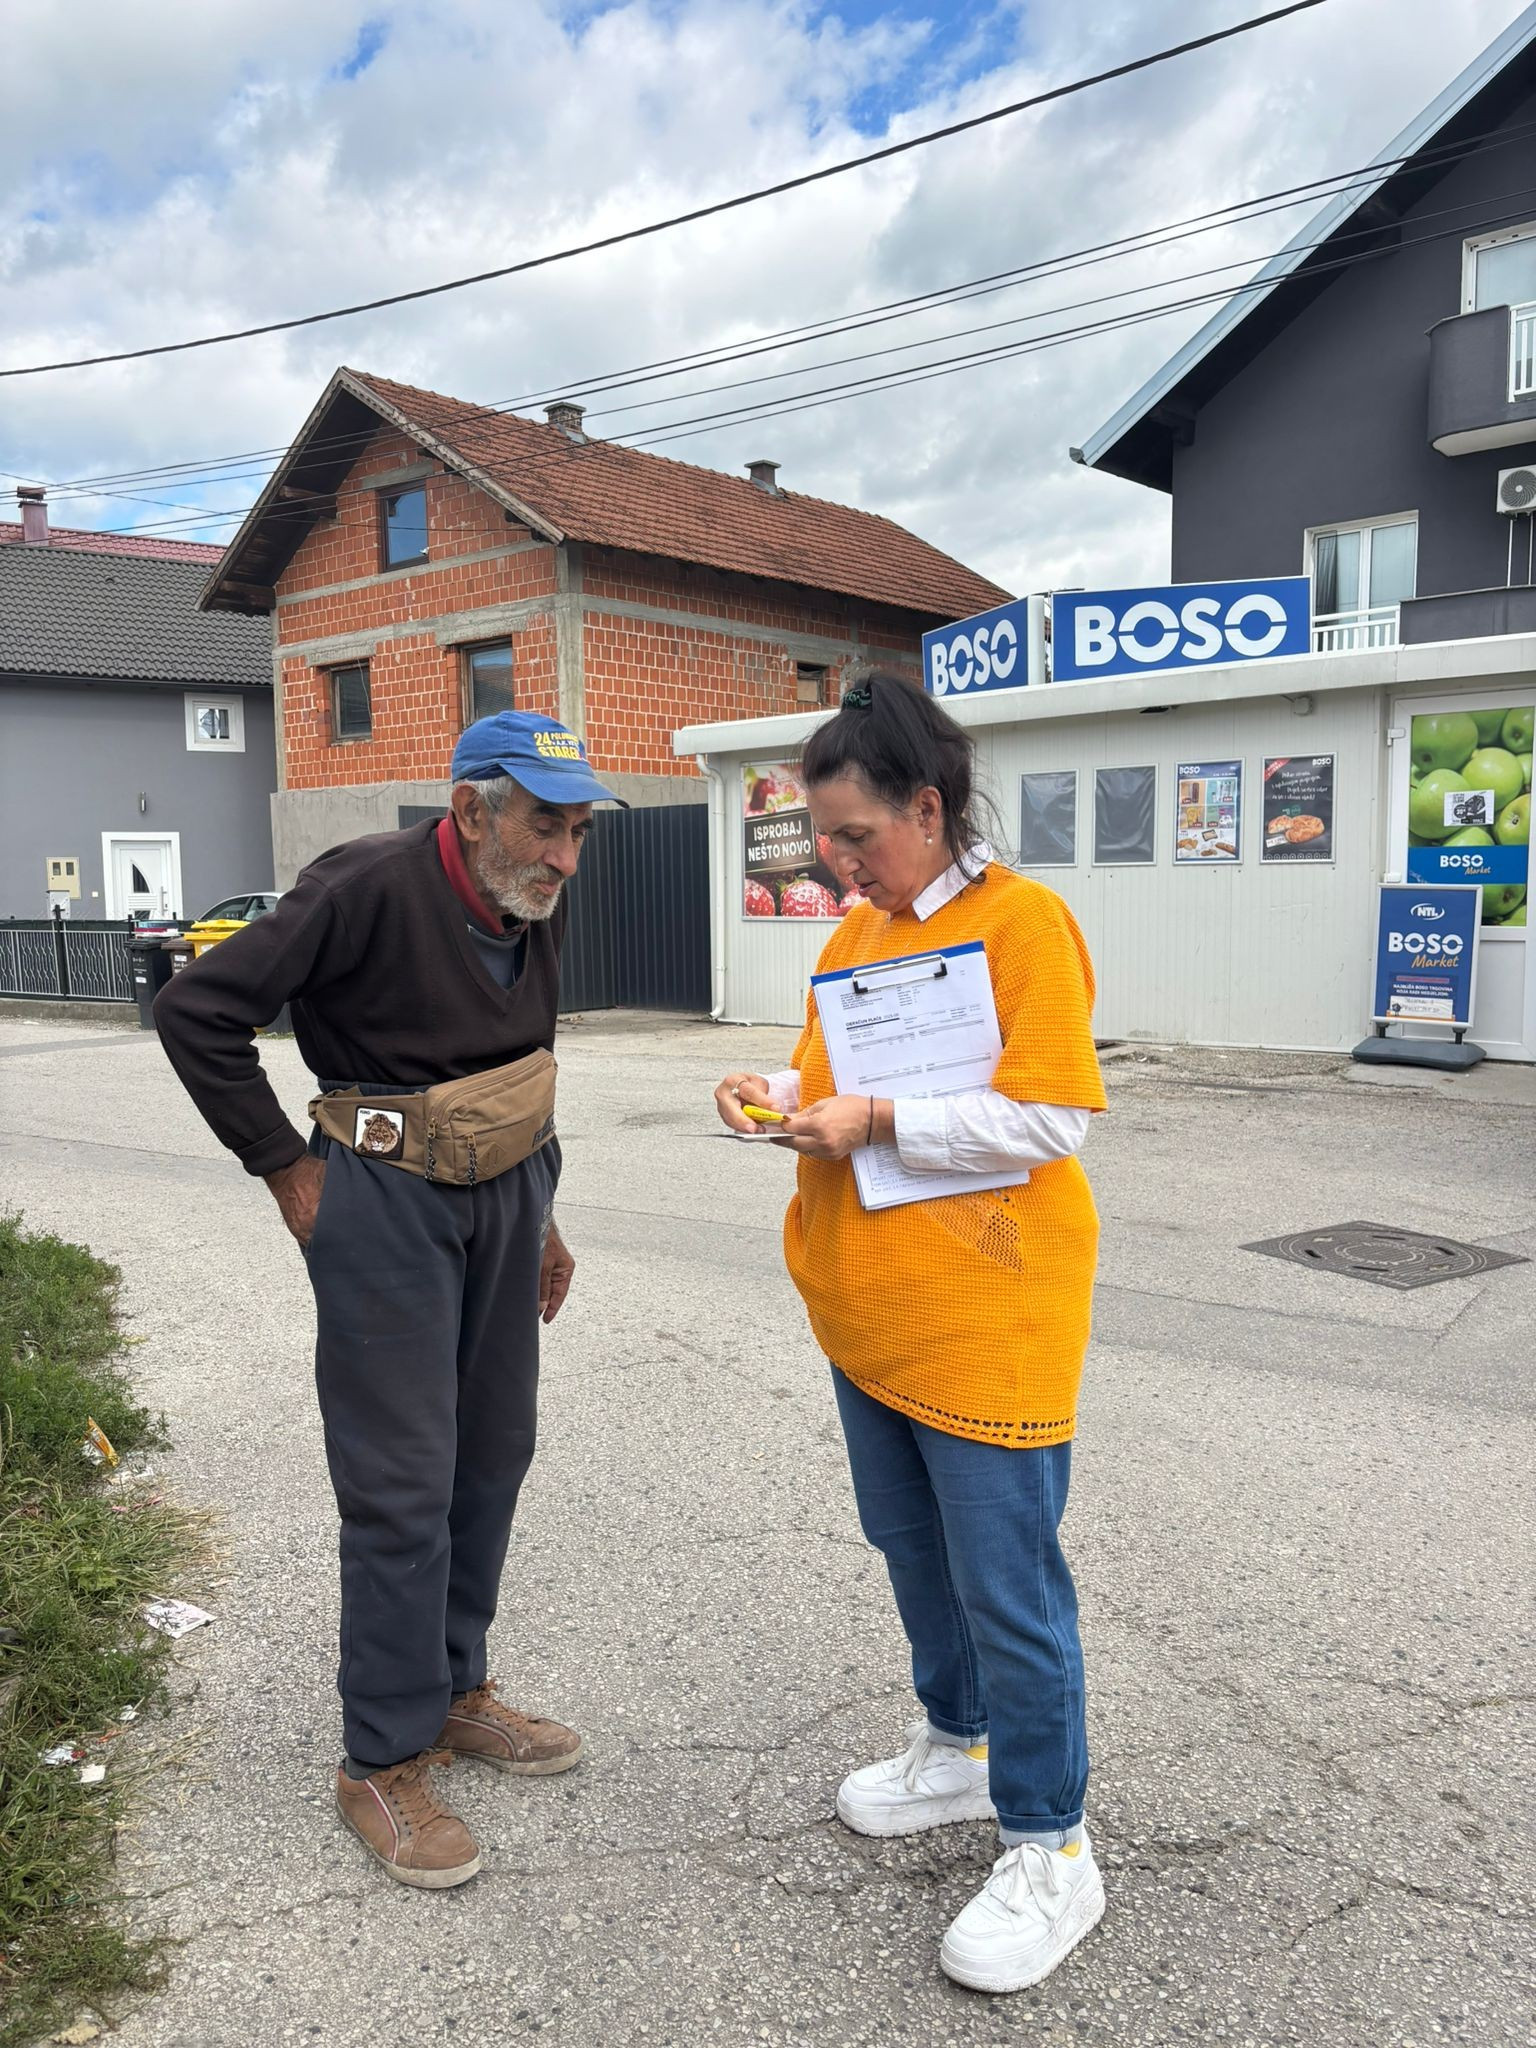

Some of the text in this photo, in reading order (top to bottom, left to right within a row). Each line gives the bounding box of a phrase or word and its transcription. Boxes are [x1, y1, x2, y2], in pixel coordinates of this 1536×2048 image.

[1074, 594, 1287, 666] BOSO
[931, 619, 1017, 696] BOSO
[534, 732, 551, 746] 24
[1179, 766, 1201, 775] BOSO
[753, 820, 802, 841] ISPROBAJ
[748, 840, 811, 862] NEŠTO NOVO
[1440, 854, 1484, 867] BOSO
[1464, 866, 1491, 875] Market
[1417, 907, 1438, 917] NTL
[1388, 932, 1464, 955] BOSO
[1411, 954, 1459, 968] Market
